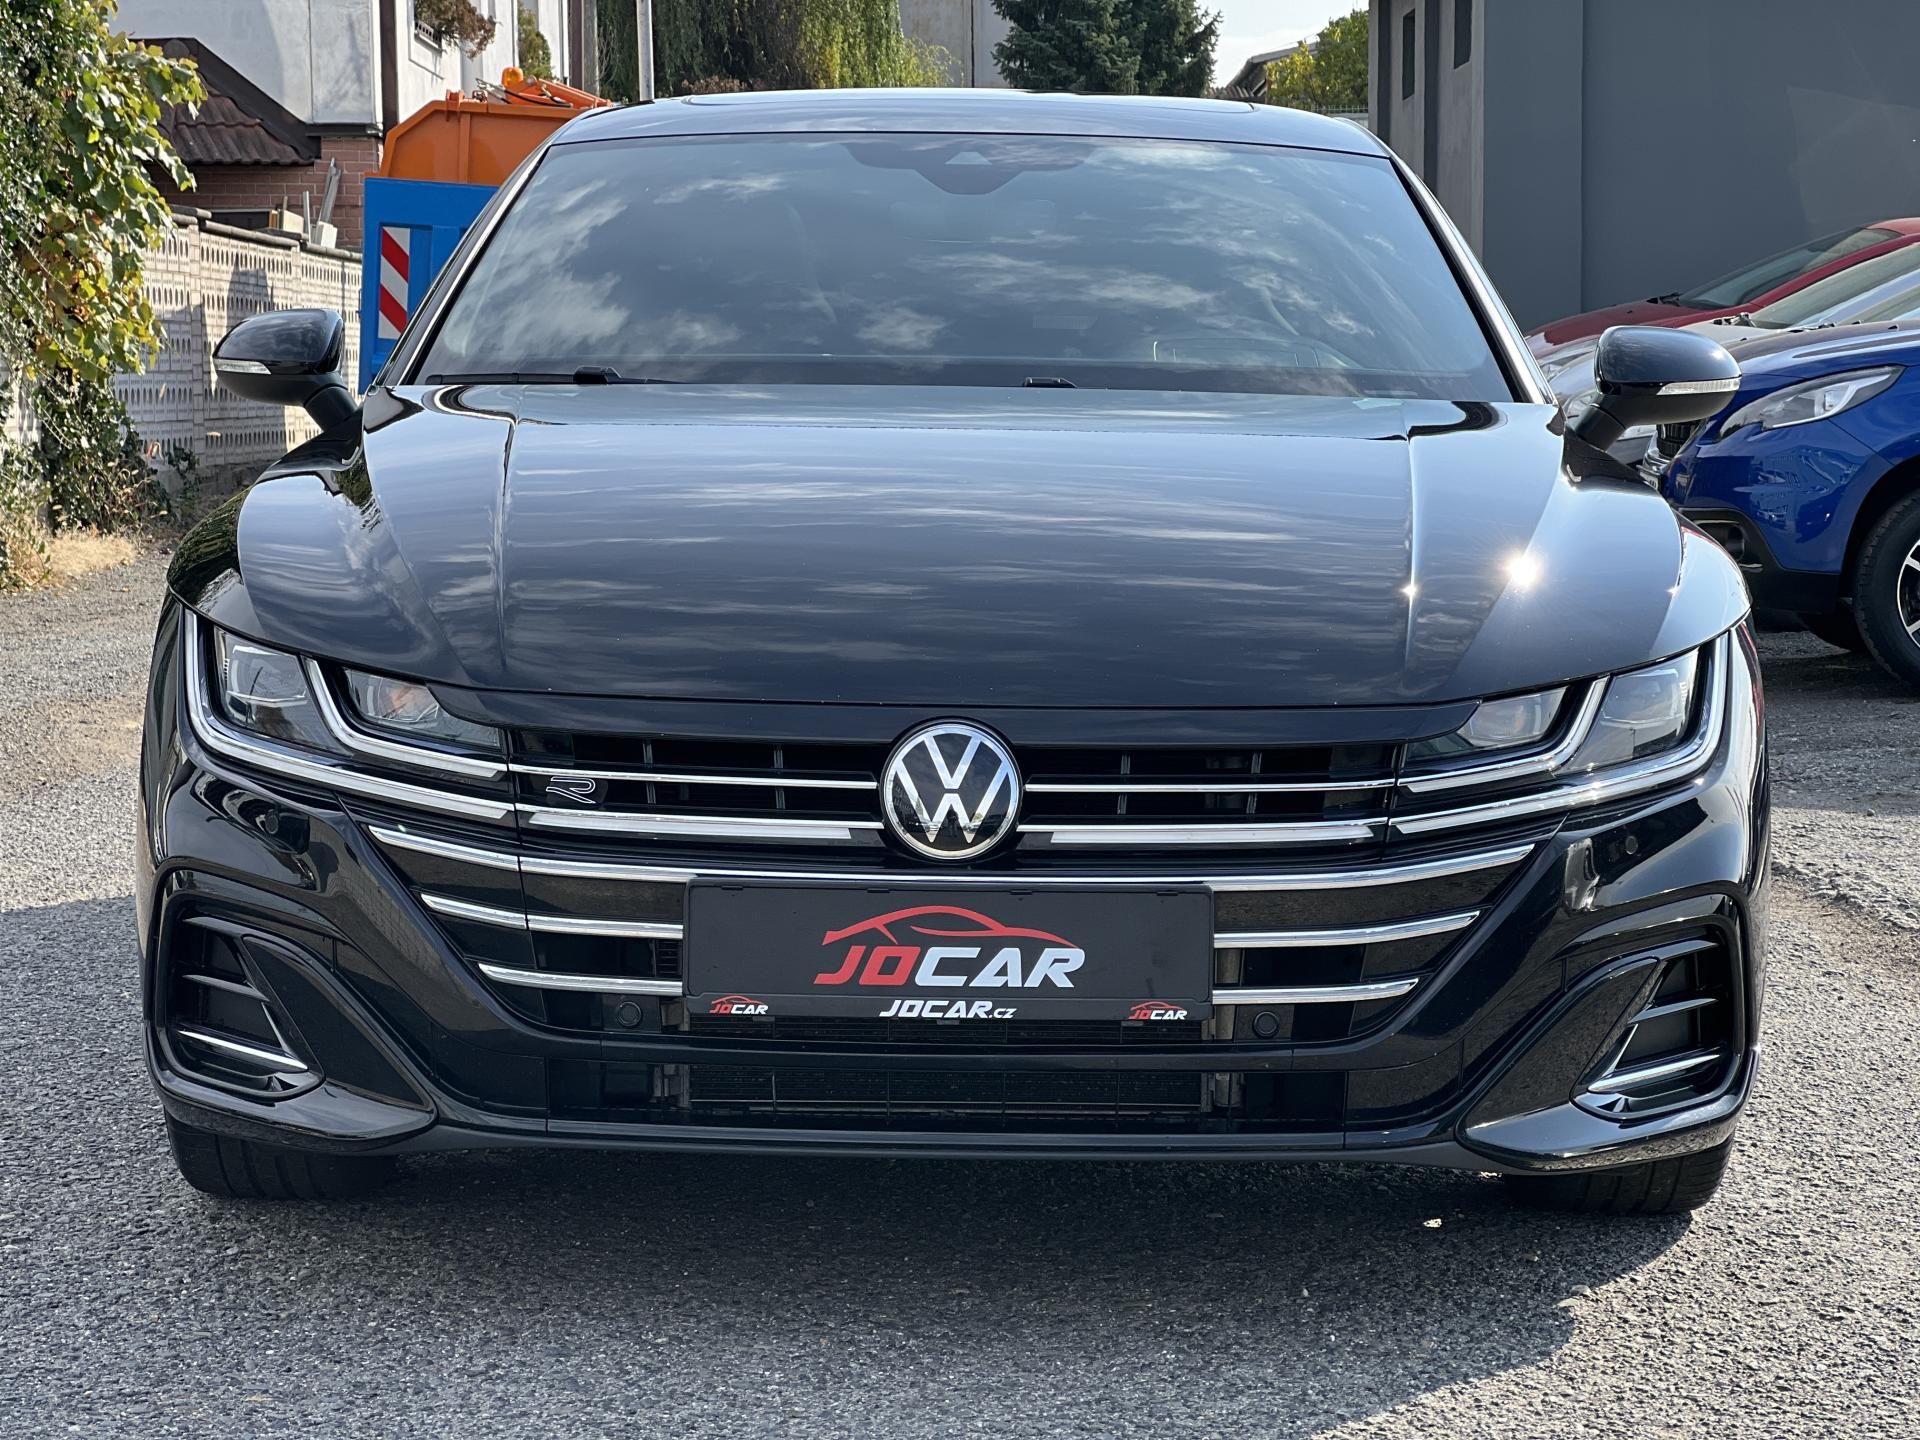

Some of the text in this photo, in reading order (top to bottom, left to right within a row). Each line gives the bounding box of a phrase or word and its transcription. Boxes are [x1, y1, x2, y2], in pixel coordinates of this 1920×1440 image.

[891, 731, 1012, 843] VW
[814, 945, 1086, 988] JOCAR
[709, 1003, 769, 1015] JOCAR
[1128, 1009, 1188, 1020] JOCAR
